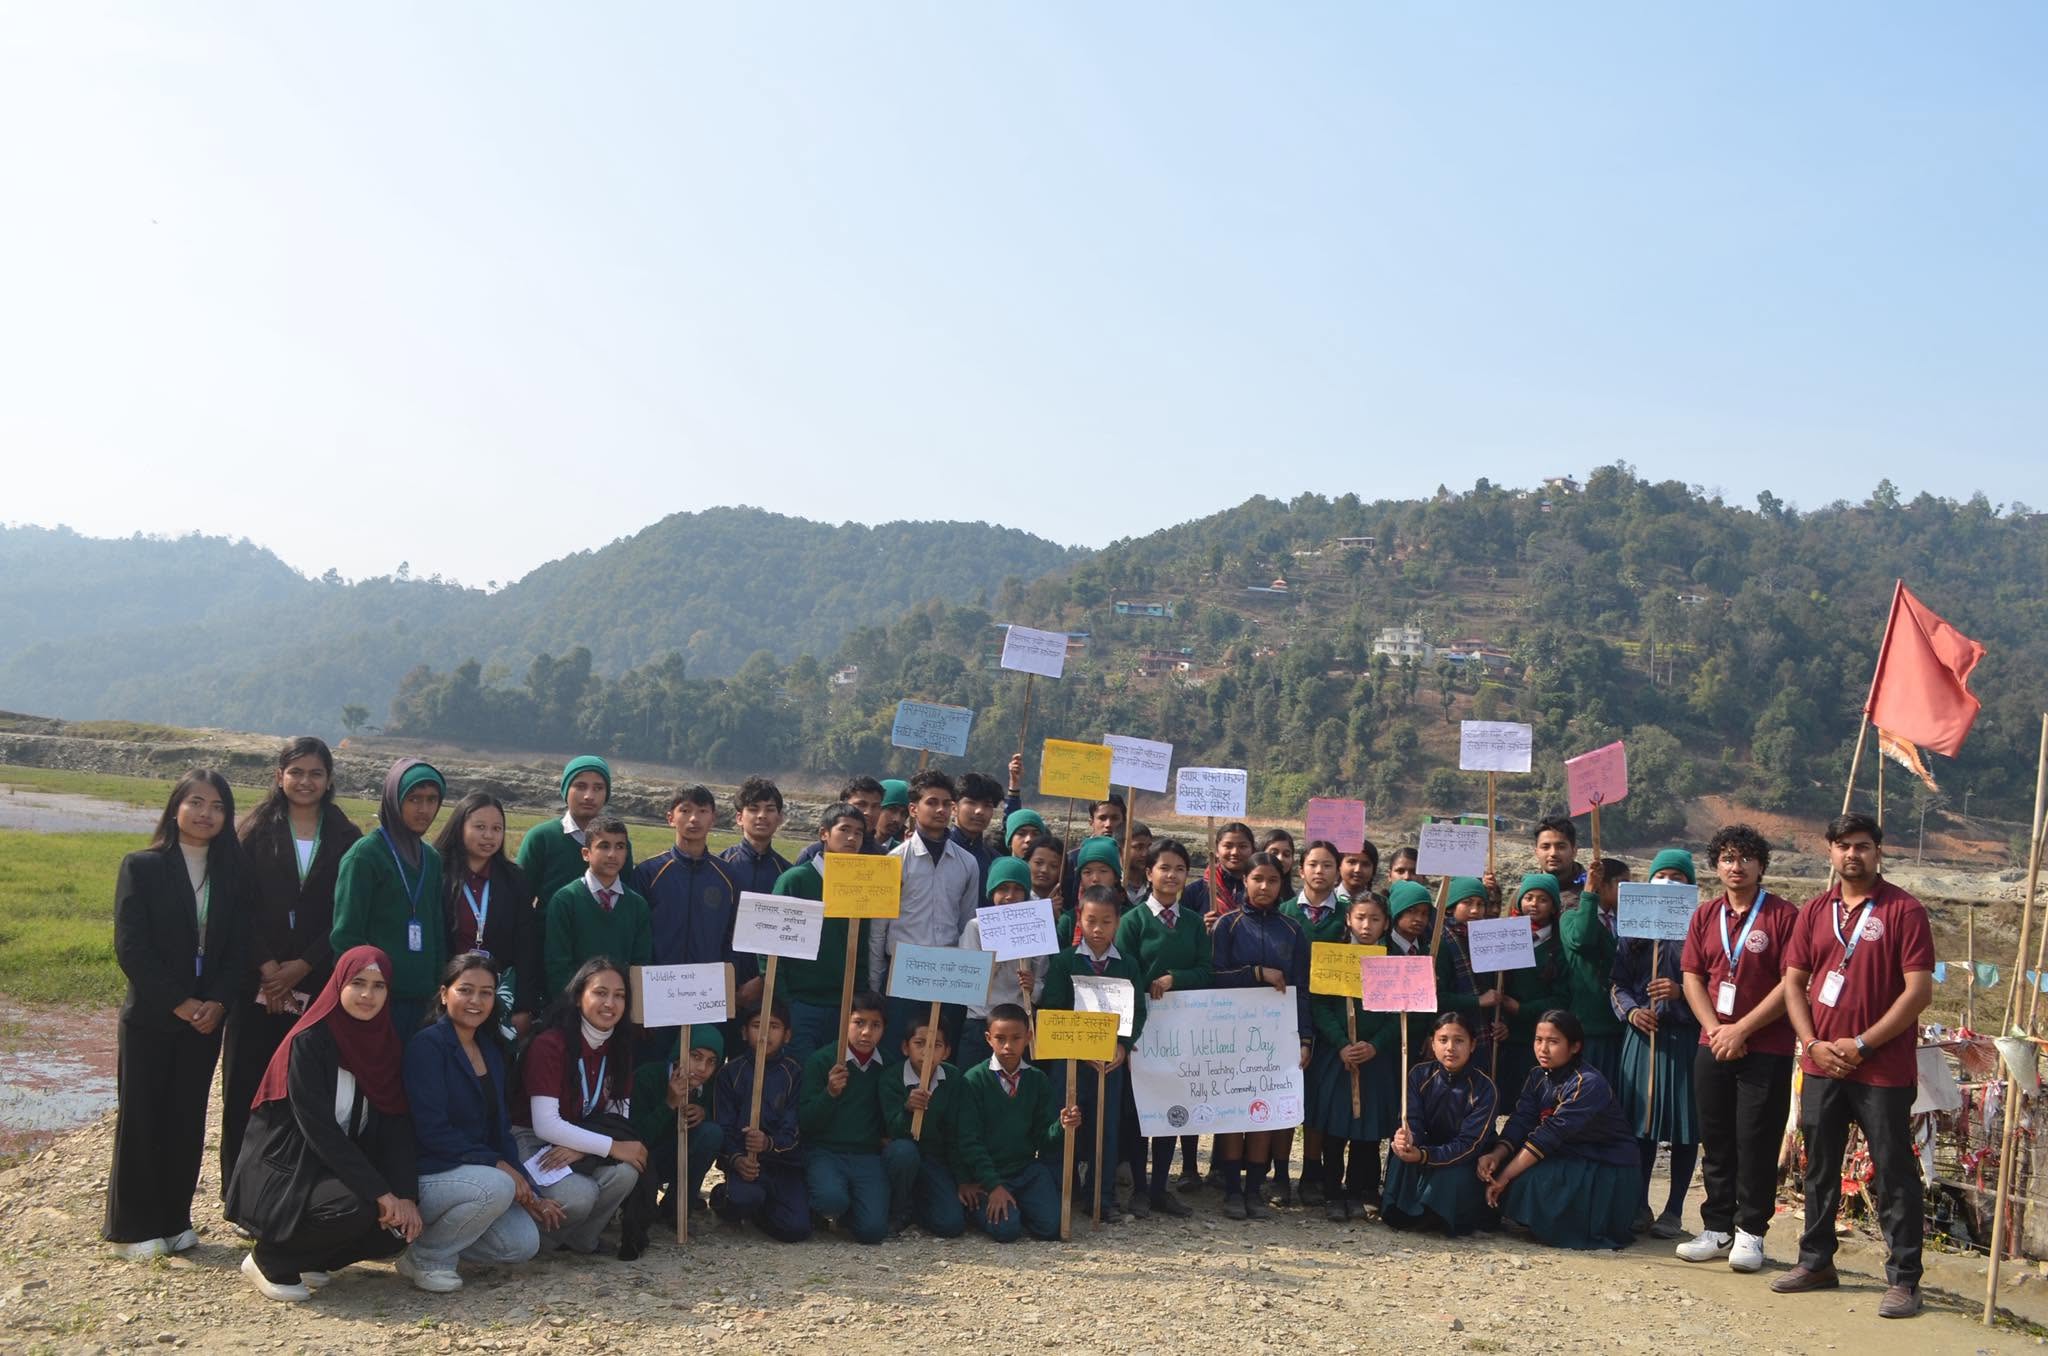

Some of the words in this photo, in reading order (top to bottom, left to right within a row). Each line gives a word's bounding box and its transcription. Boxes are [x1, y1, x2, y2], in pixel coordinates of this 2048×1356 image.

[1002, 907, 1037, 921] सिमसार
[677, 987, 697, 997] human
[1141, 1029, 1181, 1058] World
[1190, 1027, 1236, 1056] Wetland
[1246, 1026, 1276, 1060] Day
[1178, 1062, 1201, 1079] School
[1239, 1057, 1281, 1074] Conservation
[1190, 1082, 1209, 1102] Rally
[1211, 1080, 1220, 1095] &
[1224, 1078, 1257, 1097] Community
[1260, 1075, 1293, 1091] Outreach
